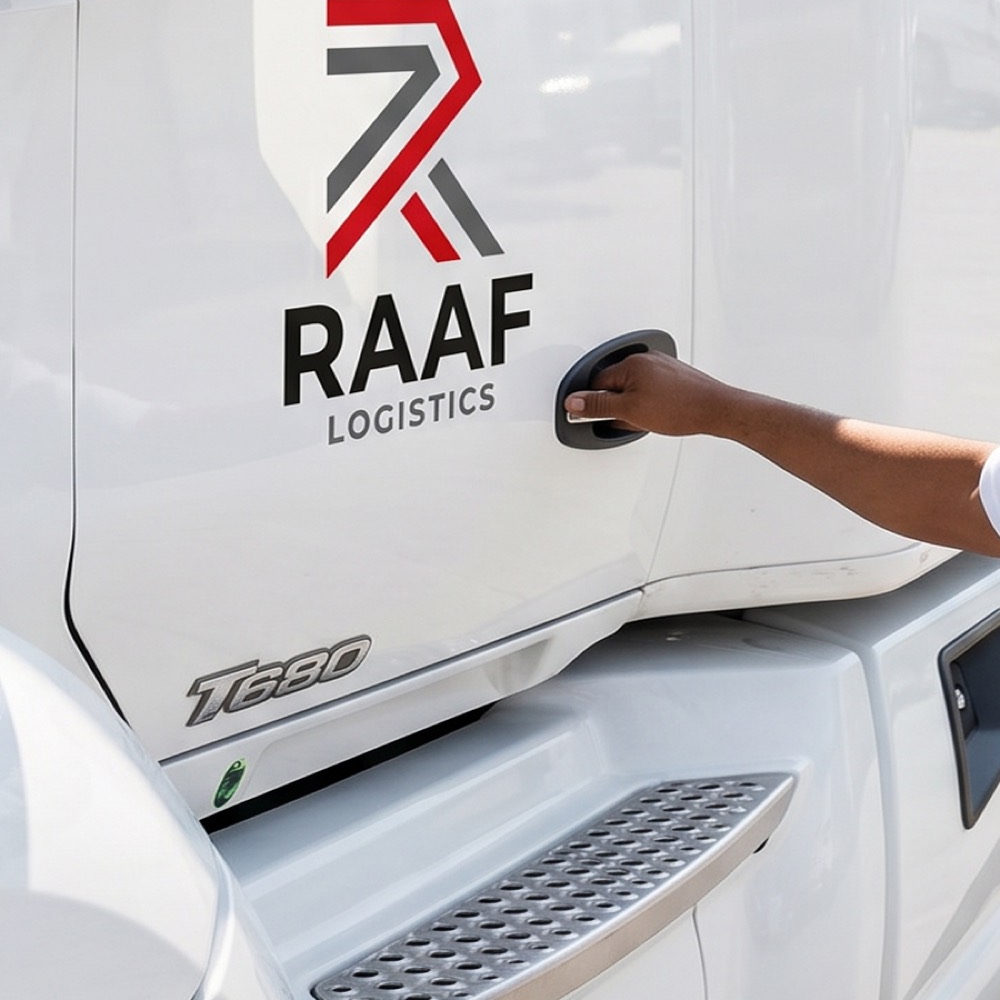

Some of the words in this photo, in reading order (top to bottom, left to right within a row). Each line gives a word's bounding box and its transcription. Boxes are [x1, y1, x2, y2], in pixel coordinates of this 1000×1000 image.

[283, 272, 534, 407] RAAF
[327, 382, 495, 445] LOGISTICS
[184, 634, 372, 727] T680
